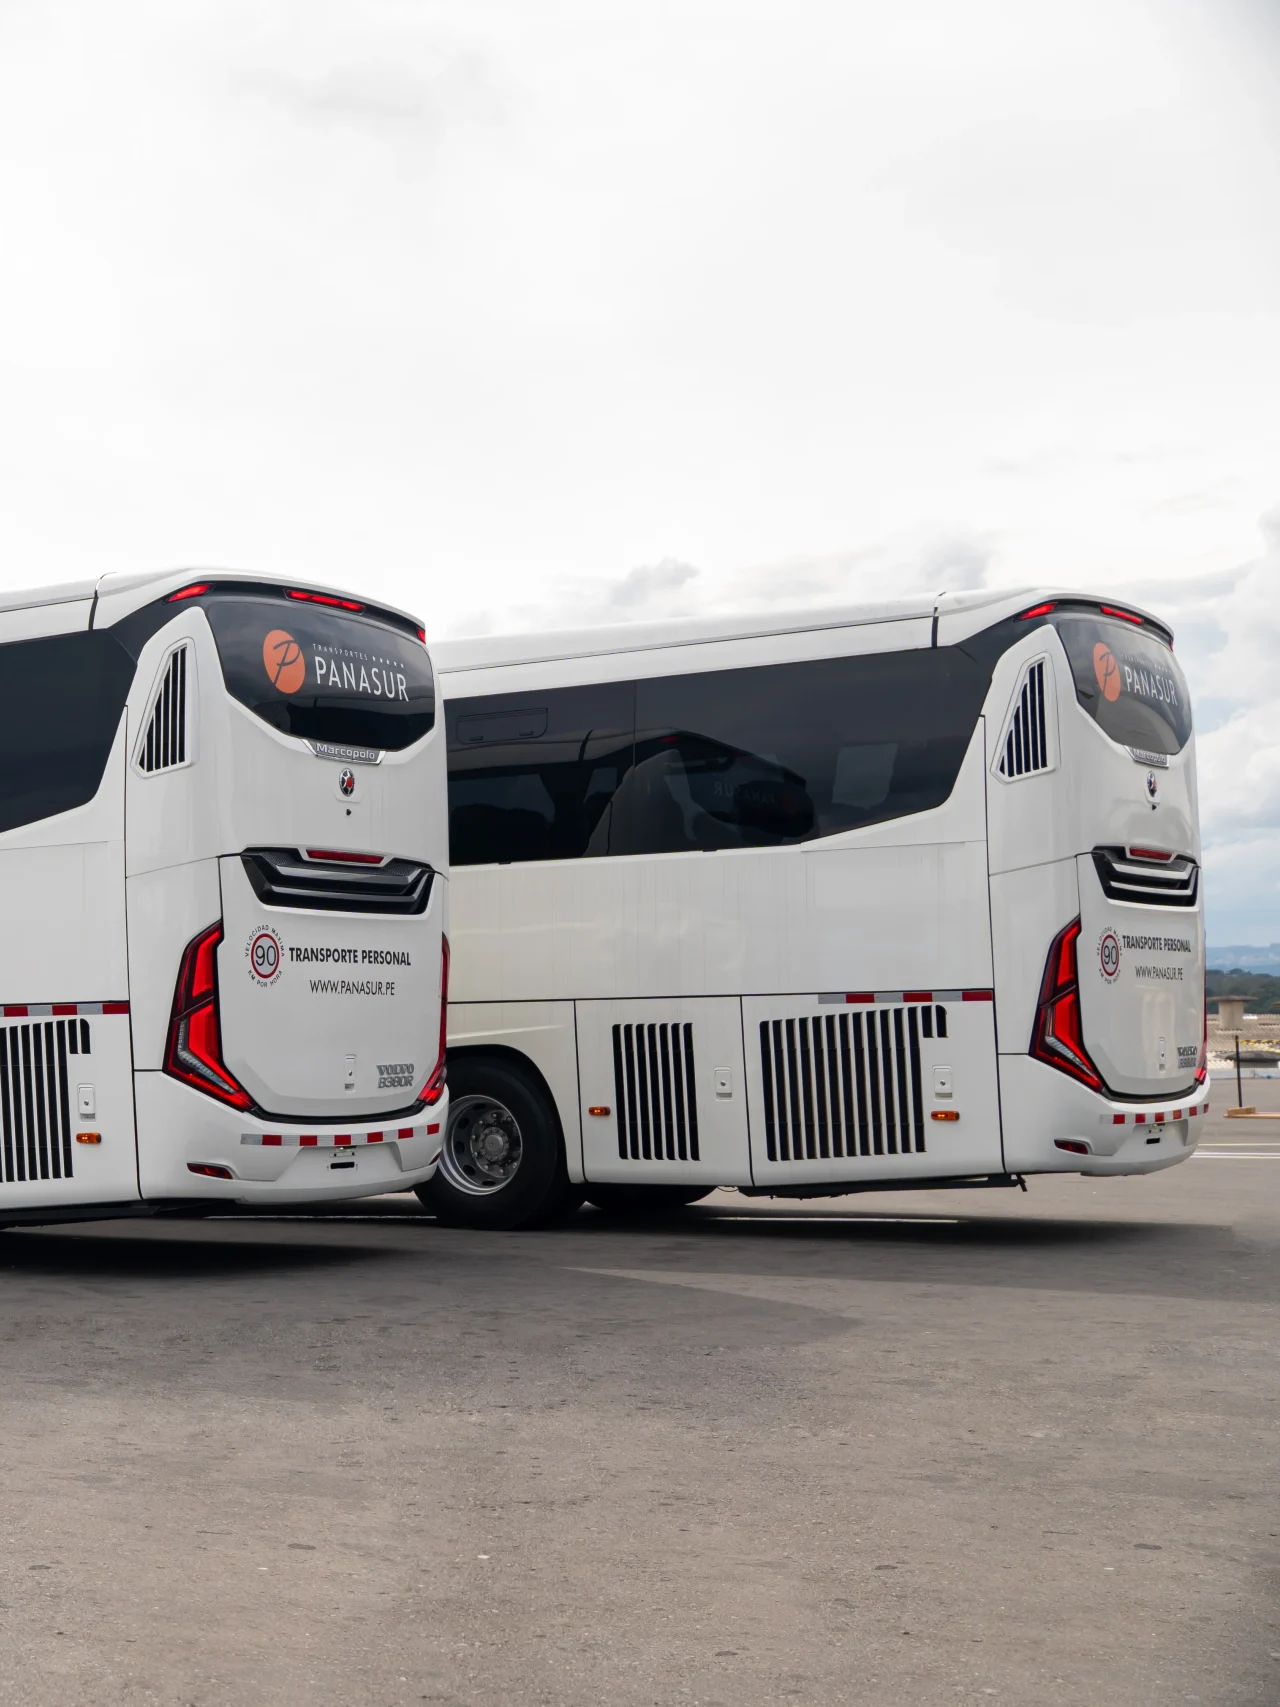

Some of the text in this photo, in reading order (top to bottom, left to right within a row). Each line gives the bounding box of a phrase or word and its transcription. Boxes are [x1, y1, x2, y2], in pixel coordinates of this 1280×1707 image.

[313, 643, 368, 660] TRANSPORTES
[315, 656, 409, 701] PANASUR
[1124, 665, 1178, 706] PANASUR
[316, 743, 375, 760] Marcopolo
[245, 924, 285, 957] VELOCIDAD MAXIMA
[1122, 935, 1191, 952] TRANSPORTE PERSONAL
[255, 945, 276, 966] 90
[289, 947, 411, 966] TRANSPORTE PERSONAL
[1104, 945, 1117, 965] 90
[1135, 965, 1183, 980] WWW.PANASUR.PE
[310, 979, 395, 996] WWW.PANASUR.PE
[376, 1063, 415, 1075] VOLVO
